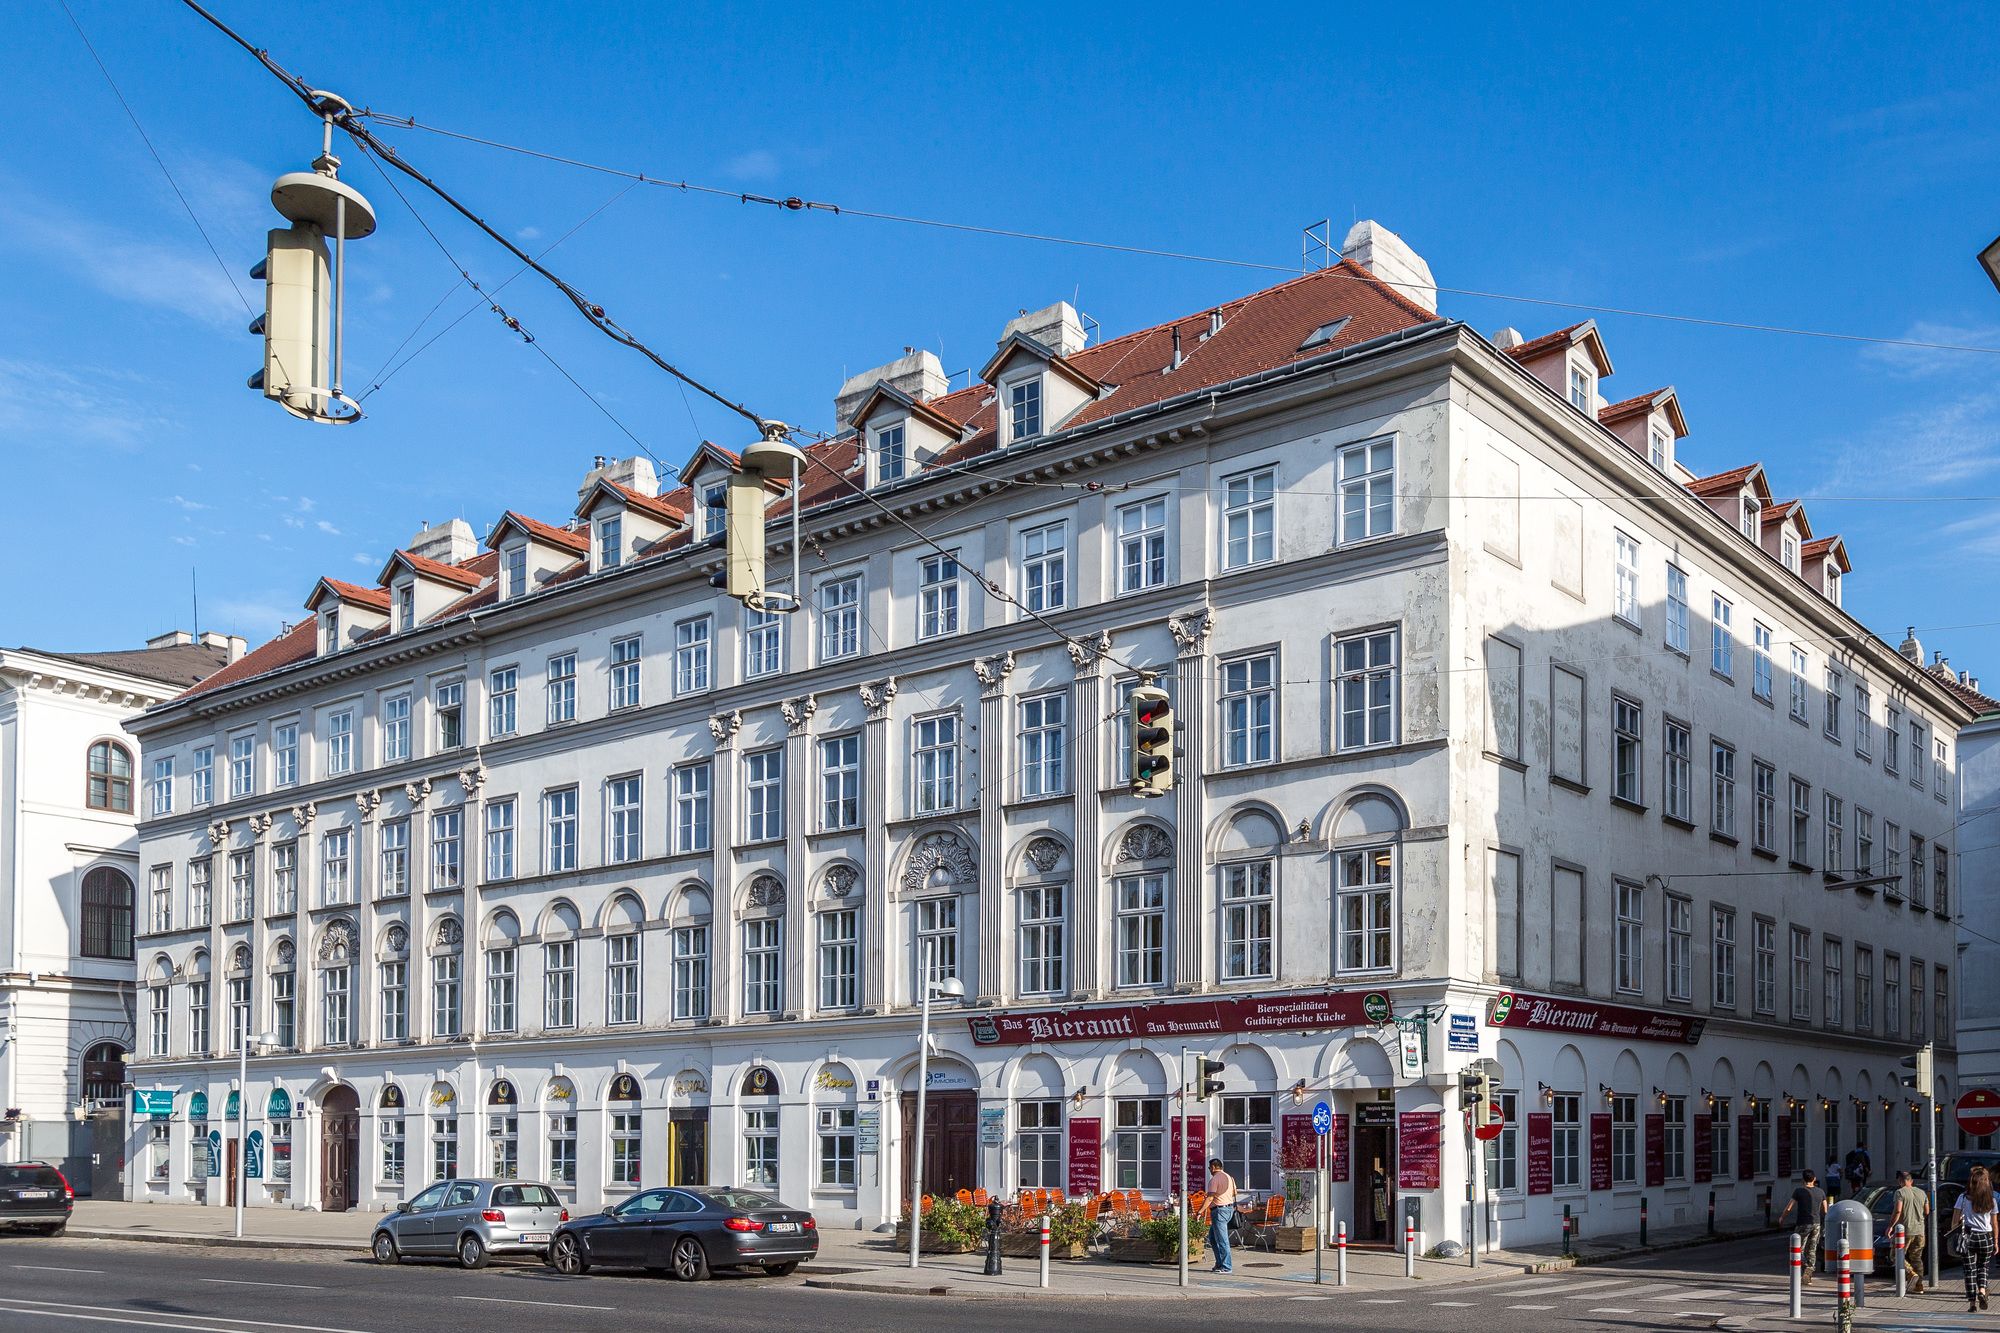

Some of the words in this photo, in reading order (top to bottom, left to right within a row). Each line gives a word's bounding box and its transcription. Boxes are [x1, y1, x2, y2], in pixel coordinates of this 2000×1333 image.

[1257, 1002, 1329, 1014] Bierspezialitäten
[1514, 997, 1531, 1010] Das
[1527, 1000, 1598, 1029] Bieramt
[1146, 1022, 1165, 1032] Am
[1168, 1018, 1220, 1033] Heumarkt
[1245, 1014, 1313, 1027] Gutbürgerliche
[1315, 1012, 1346, 1023] Küche
[1001, 1019, 1022, 1030] Das
[1026, 1014, 1133, 1041] Bieramt
